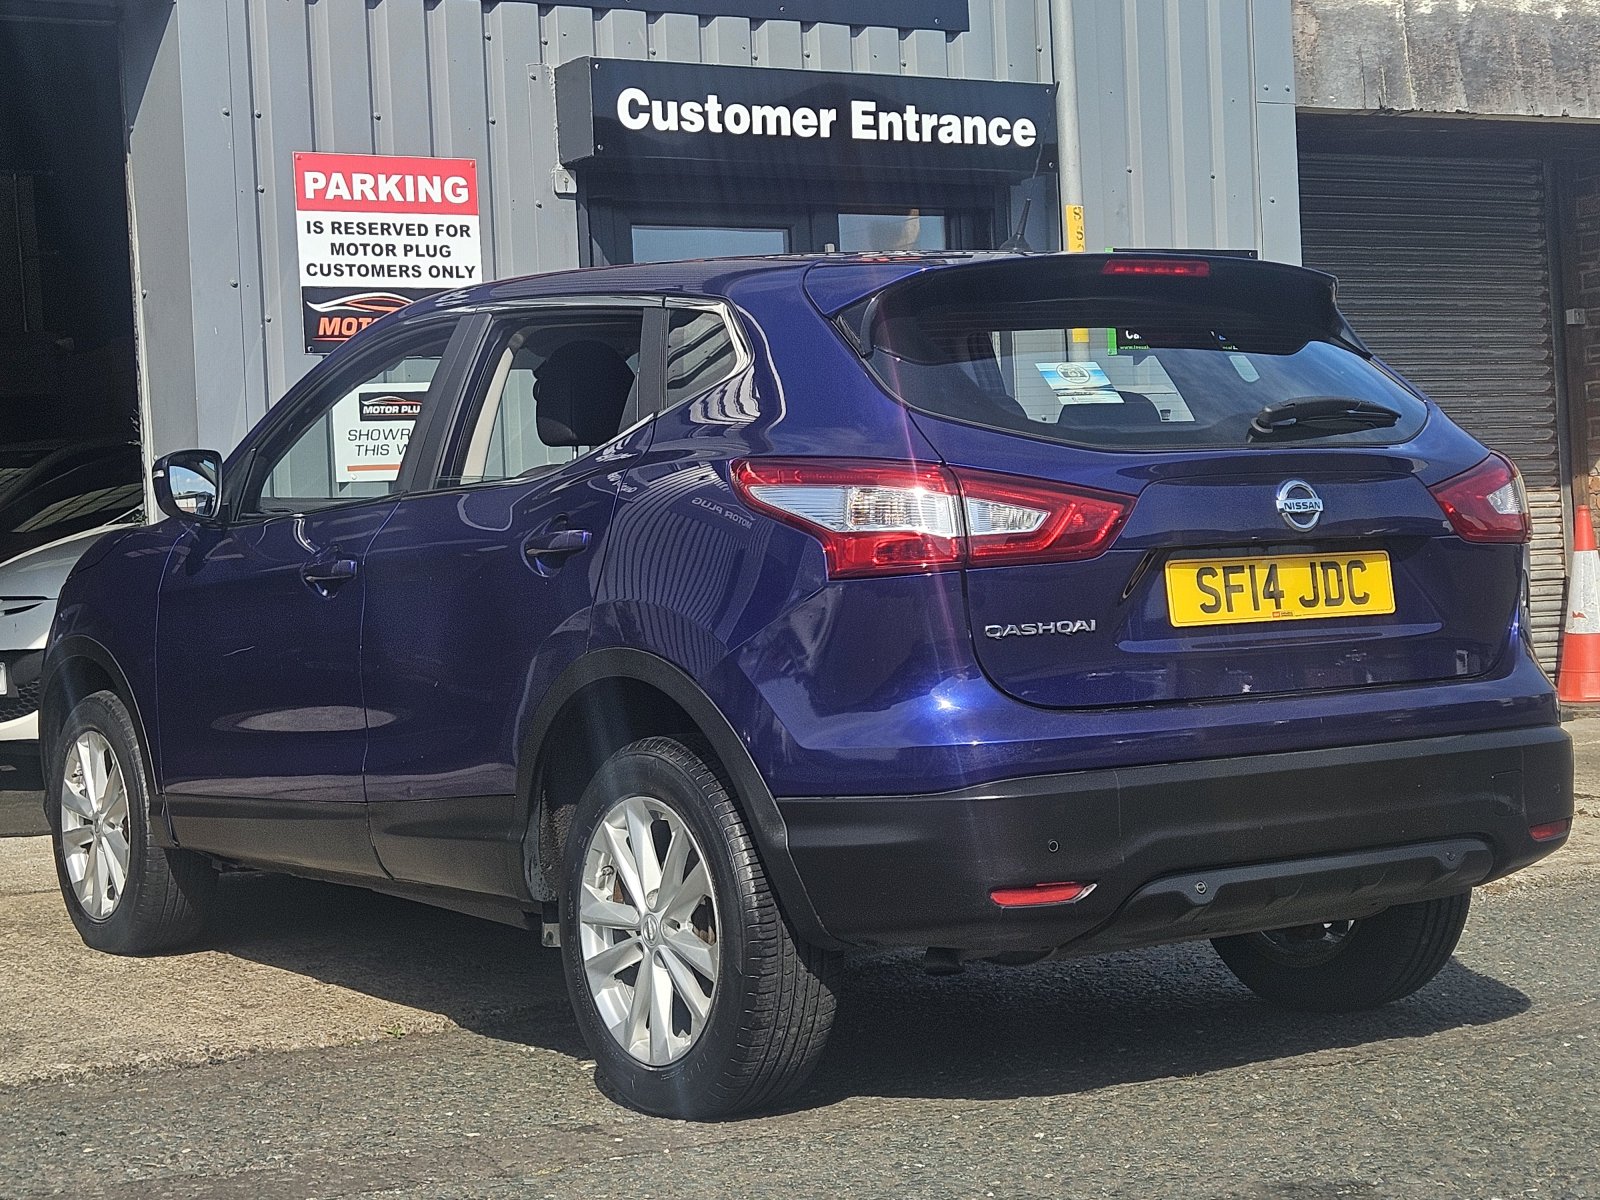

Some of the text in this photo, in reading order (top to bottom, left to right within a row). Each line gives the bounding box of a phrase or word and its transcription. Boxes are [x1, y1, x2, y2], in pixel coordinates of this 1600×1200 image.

[616, 87, 1037, 148] Customer Entrance
[303, 171, 469, 204] PARKING
[306, 220, 471, 238] IS RESERVED FOR
[330, 242, 451, 258] MOTOR PLUG
[306, 263, 476, 279] CUSTOMERS ONLY
[318, 317, 378, 335] MOT
[363, 405, 420, 414] MOTOR PLU
[355, 444, 390, 456] THIS
[1284, 501, 1320, 510] NISSAN
[1196, 559, 1370, 614] SF14 JDC
[984, 619, 1096, 640] QASHQAI
